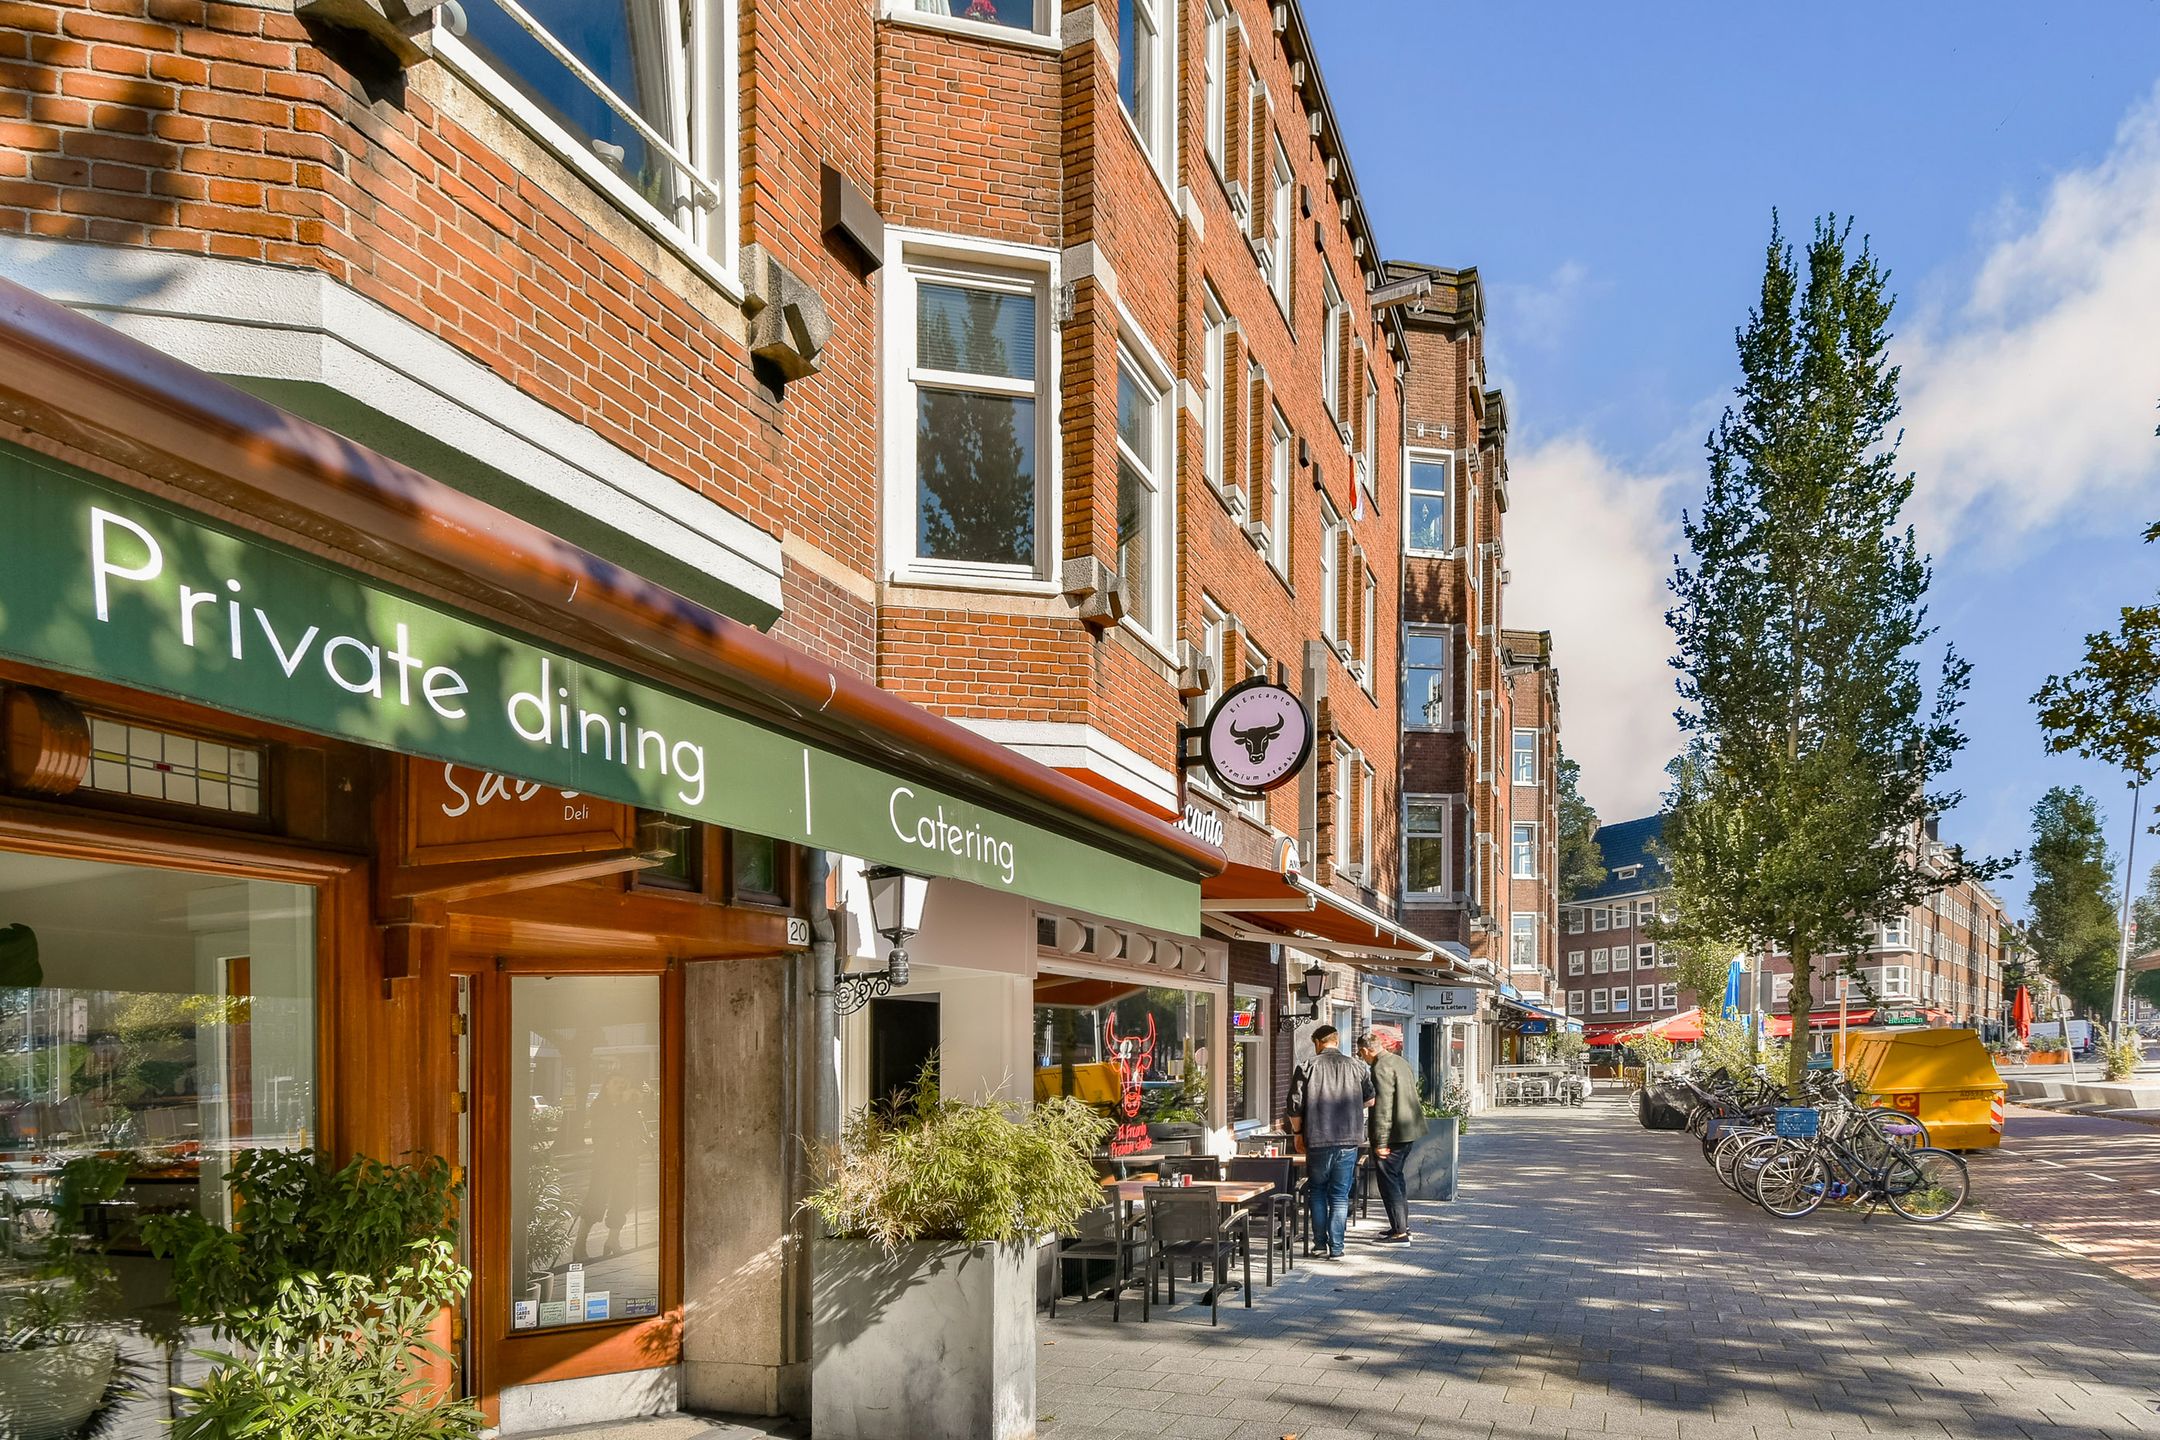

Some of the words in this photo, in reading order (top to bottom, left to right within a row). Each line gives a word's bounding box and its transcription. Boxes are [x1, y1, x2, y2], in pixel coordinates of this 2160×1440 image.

[90, 506, 469, 720] Private
[507, 658, 706, 806] dining
[564, 804, 589, 821] Deli
[889, 787, 1015, 884] Catering
[790, 921, 807, 942] 20
